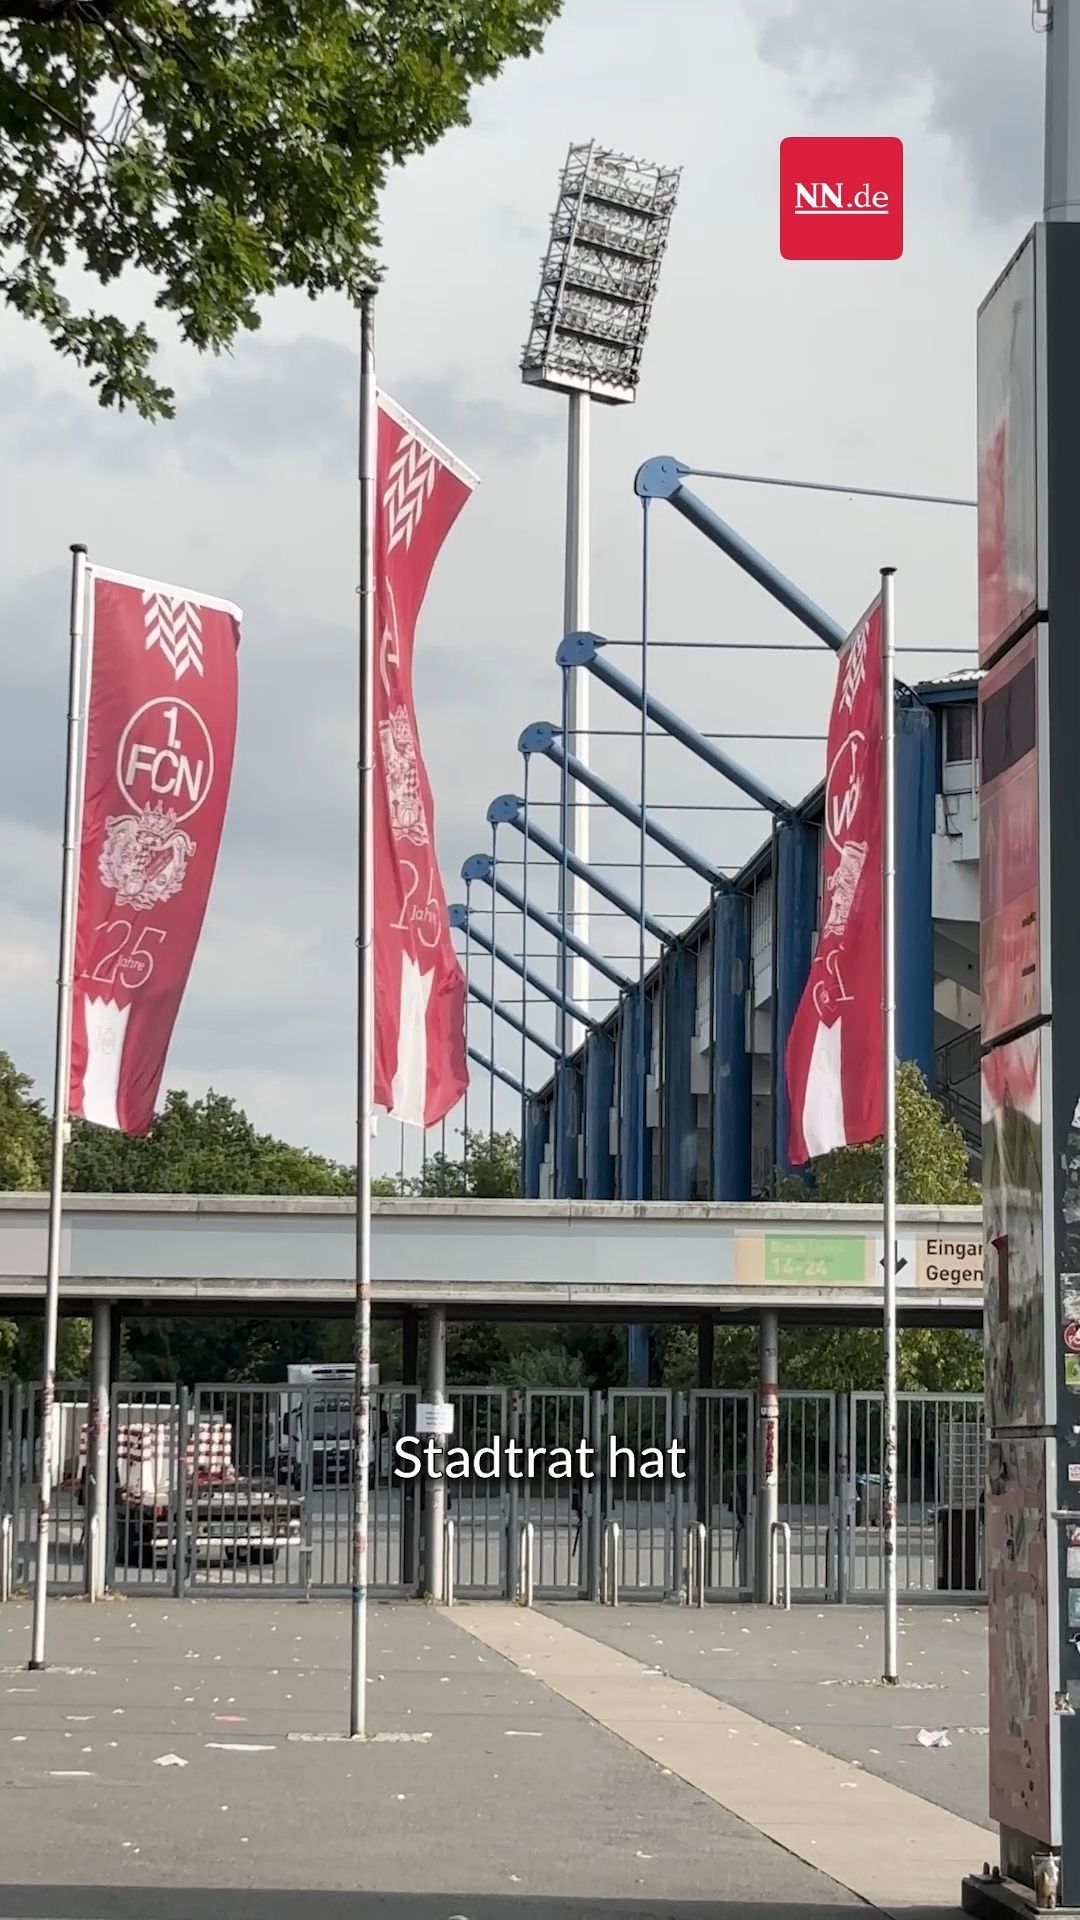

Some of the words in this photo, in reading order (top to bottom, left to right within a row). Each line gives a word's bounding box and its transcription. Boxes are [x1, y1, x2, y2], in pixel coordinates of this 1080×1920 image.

[163, 706, 181, 749] 1.
[125, 743, 203, 801] FCN
[926, 1265, 984, 1285] Gegen
